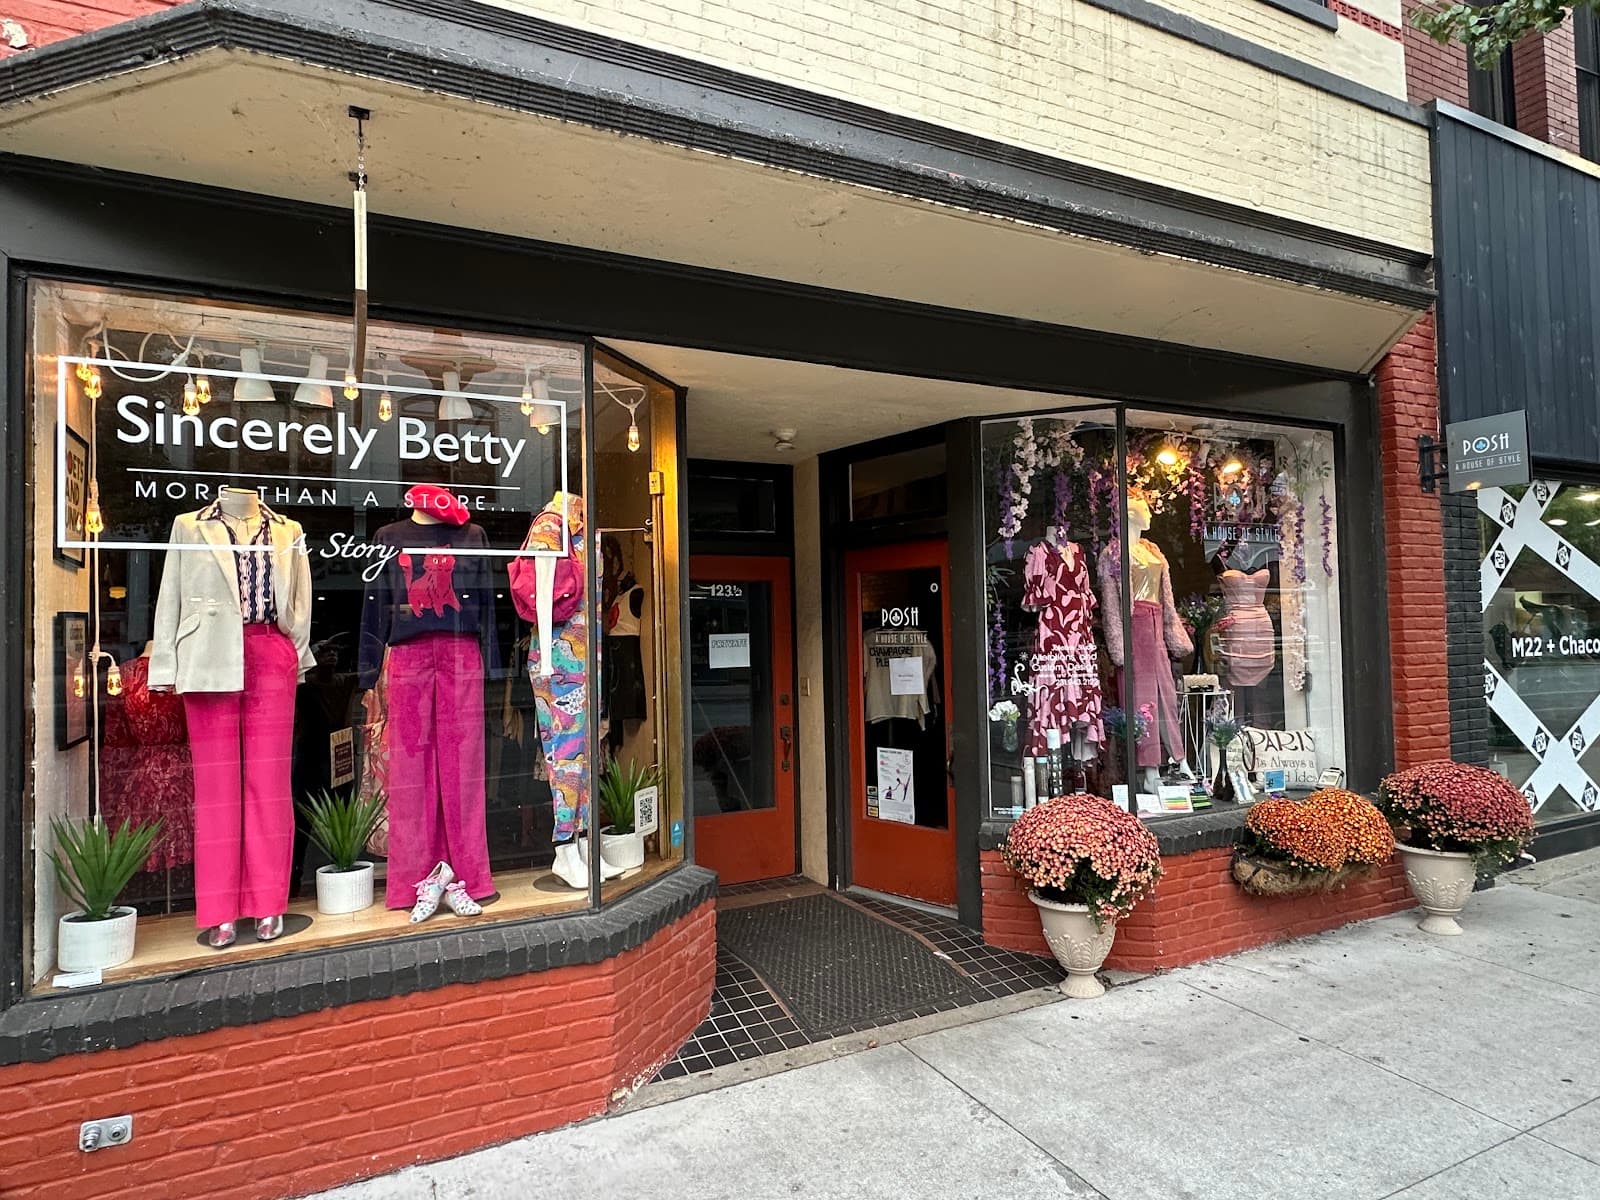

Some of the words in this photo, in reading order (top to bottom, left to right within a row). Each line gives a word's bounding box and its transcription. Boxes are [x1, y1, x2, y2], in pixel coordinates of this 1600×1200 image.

[116, 394, 378, 470] Sincerely
[399, 416, 527, 478] Betty
[1463, 432, 1509, 456] POSH
[1455, 463, 1460, 471] A
[1462, 459, 1483, 470] HOUSE
[1487, 457, 1494, 467] OF
[1499, 453, 1521, 465] STYLE
[135, 480, 230, 501] MORE
[257, 485, 336, 505] THAN
[363, 490, 379, 506] A
[1203, 526, 1209, 540] A
[1212, 526, 1237, 540] HOUSE
[1241, 527, 1250, 541] OF
[1255, 527, 1281, 542] STYLE
[278, 532, 312, 557] A
[319, 532, 400, 583] Story
[881, 606, 919, 627] POSH
[909, 632, 928, 644] STYLE
[1511, 636, 1543, 658] M22
[1559, 634, 1600, 655] Chaco
[1246, 729, 1316, 753] PARIS
[1255, 756, 1267, 769] is
[1270, 754, 1308, 770] Always
[1308, 759, 1315, 769] a
